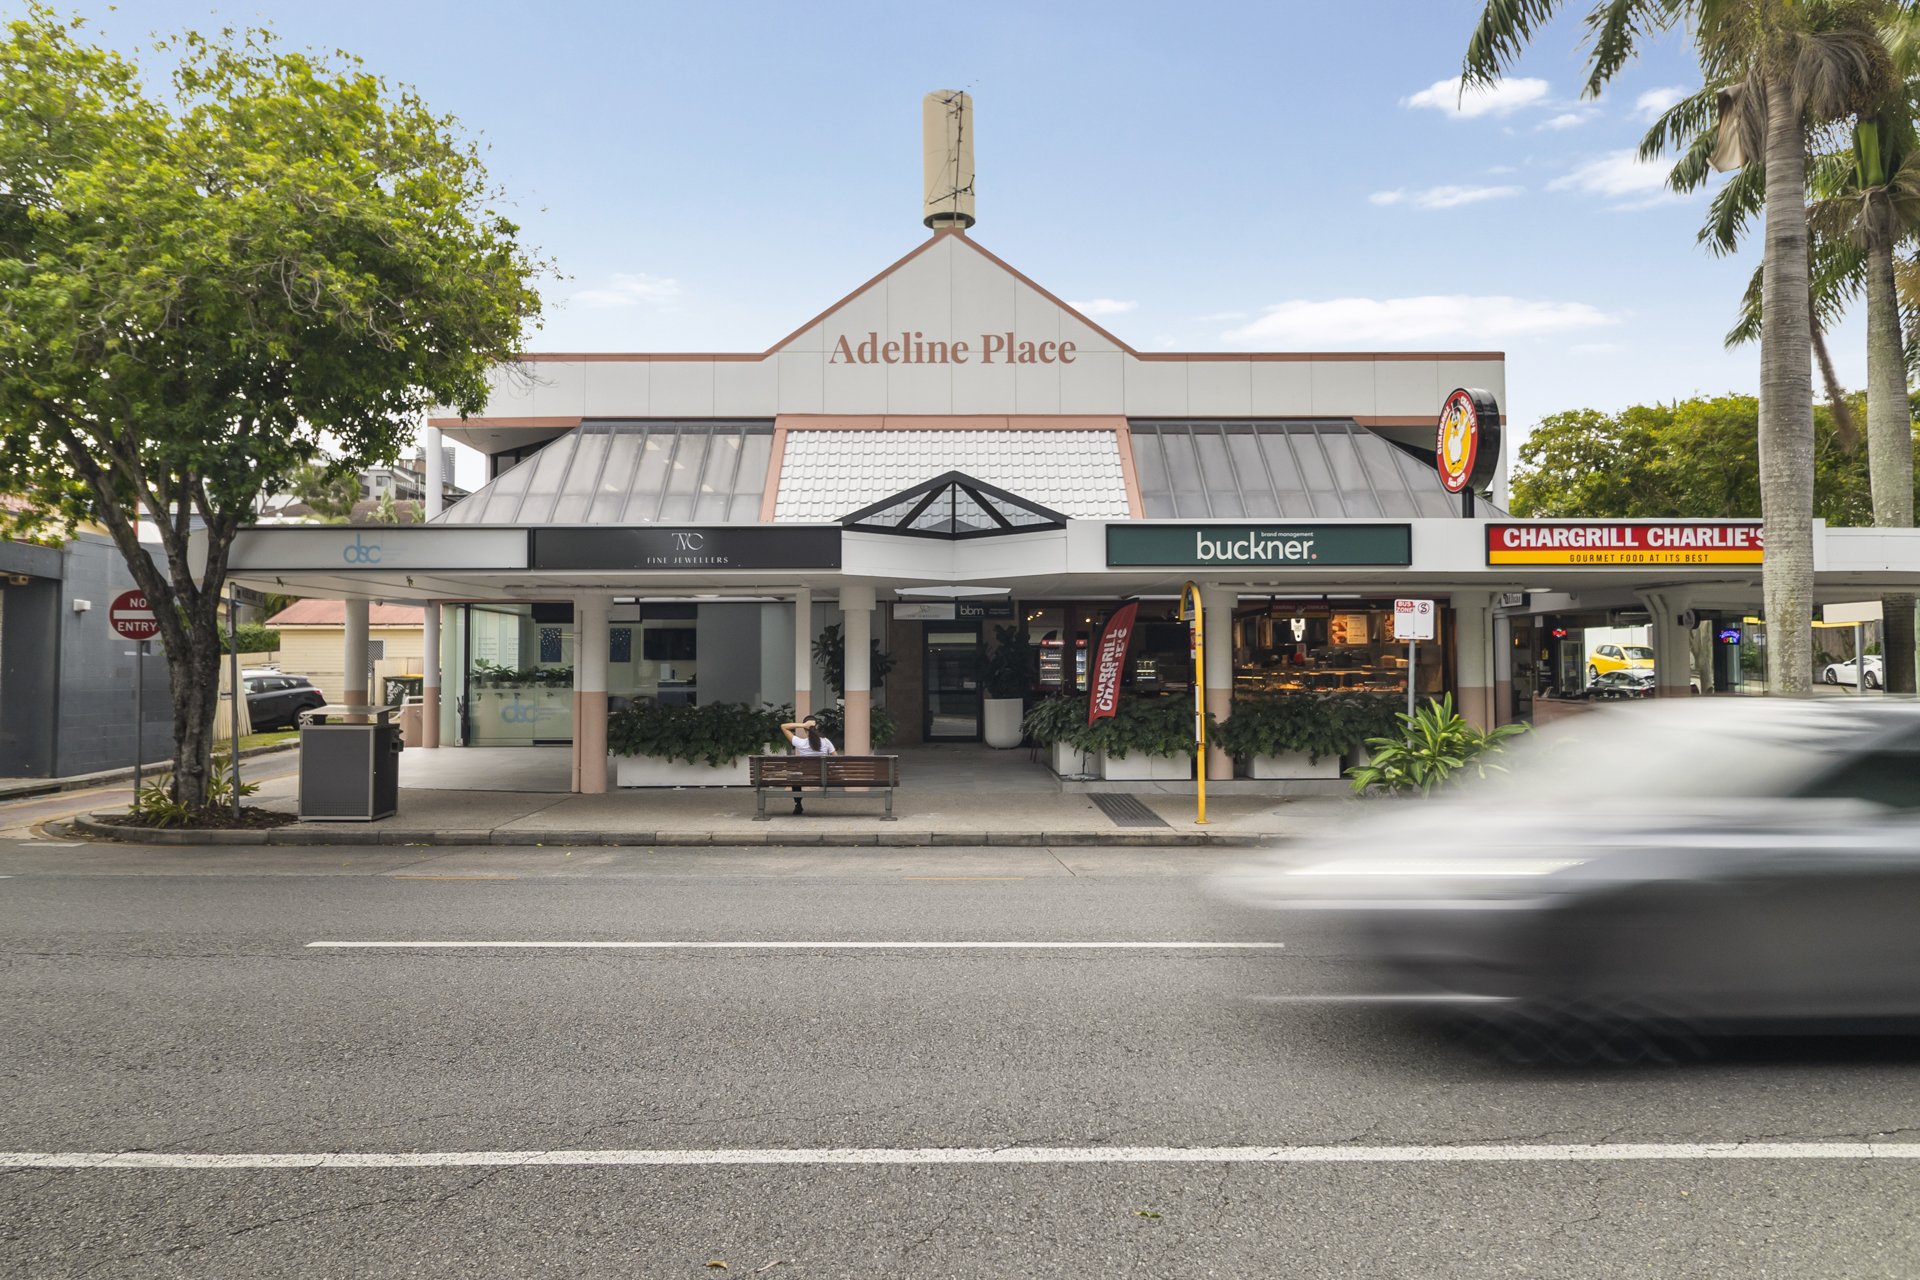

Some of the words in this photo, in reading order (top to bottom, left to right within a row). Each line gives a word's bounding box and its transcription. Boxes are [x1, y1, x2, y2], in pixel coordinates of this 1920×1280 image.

[828, 331, 970, 364] Adeline
[980, 331, 1077, 364] Place
[1502, 527, 1640, 547] CHARGRILL
[1196, 531, 1317, 560] buckner.
[673, 556, 729, 564] JEWELLERS
[1569, 554, 1616, 563] GOURMET
[1620, 554, 1645, 563] FOOD
[1649, 554, 1660, 563] AT
[1664, 554, 1681, 563] ITS
[1685, 554, 1709, 563] BEST
[129, 598, 147, 608] NO
[960, 604, 984, 616] bbm
[117, 621, 158, 632] ENTRY
